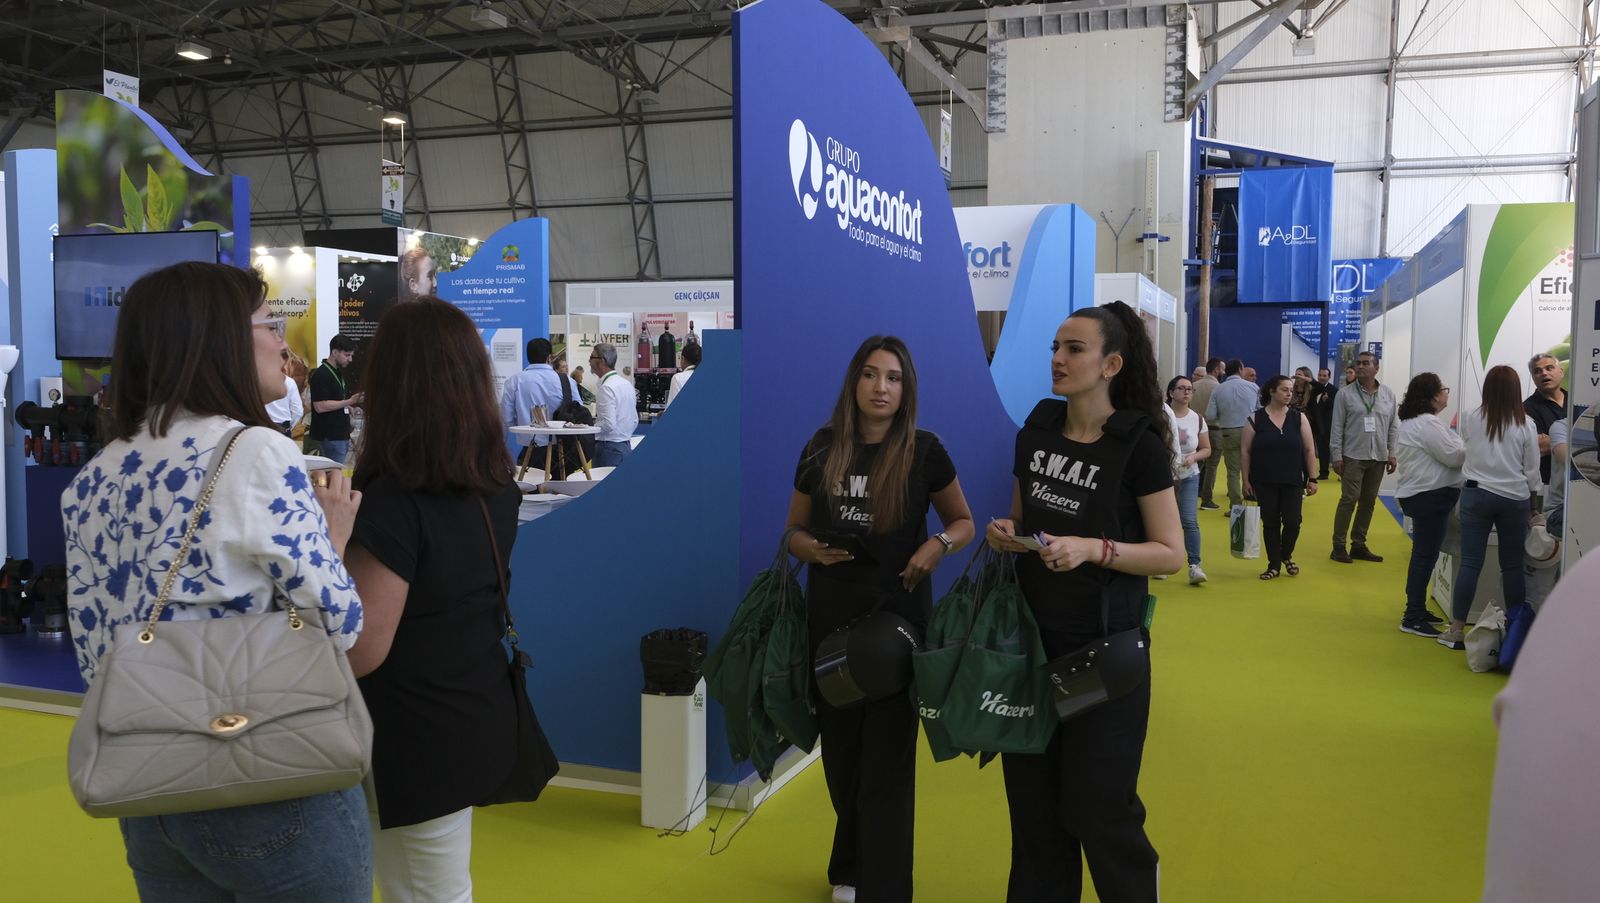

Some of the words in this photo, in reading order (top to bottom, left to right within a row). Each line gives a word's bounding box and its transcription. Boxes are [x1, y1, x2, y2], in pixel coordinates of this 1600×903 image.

[826, 136, 860, 173] GRUPO
[825, 163, 923, 245] aguaconfort
[848, 221, 865, 242] Todo
[865, 232, 880, 247] para
[880, 235, 886, 249] el
[886, 240, 899, 256] agua
[903, 244, 909, 258] el
[909, 246, 922, 263] clima
[972, 270, 981, 279] el
[983, 269, 1009, 278] clima
[485, 277, 494, 285] de
[503, 276, 526, 284] cultivo
[473, 287, 498, 295] tiempo
[499, 286, 514, 294] real
[674, 291, 692, 302] GENÇ
[693, 289, 720, 302] GÜÇSAN
[286, 297, 309, 306] eficaz.
[345, 299, 365, 309] poder
[1030, 450, 1100, 490] S.W.A.T.
